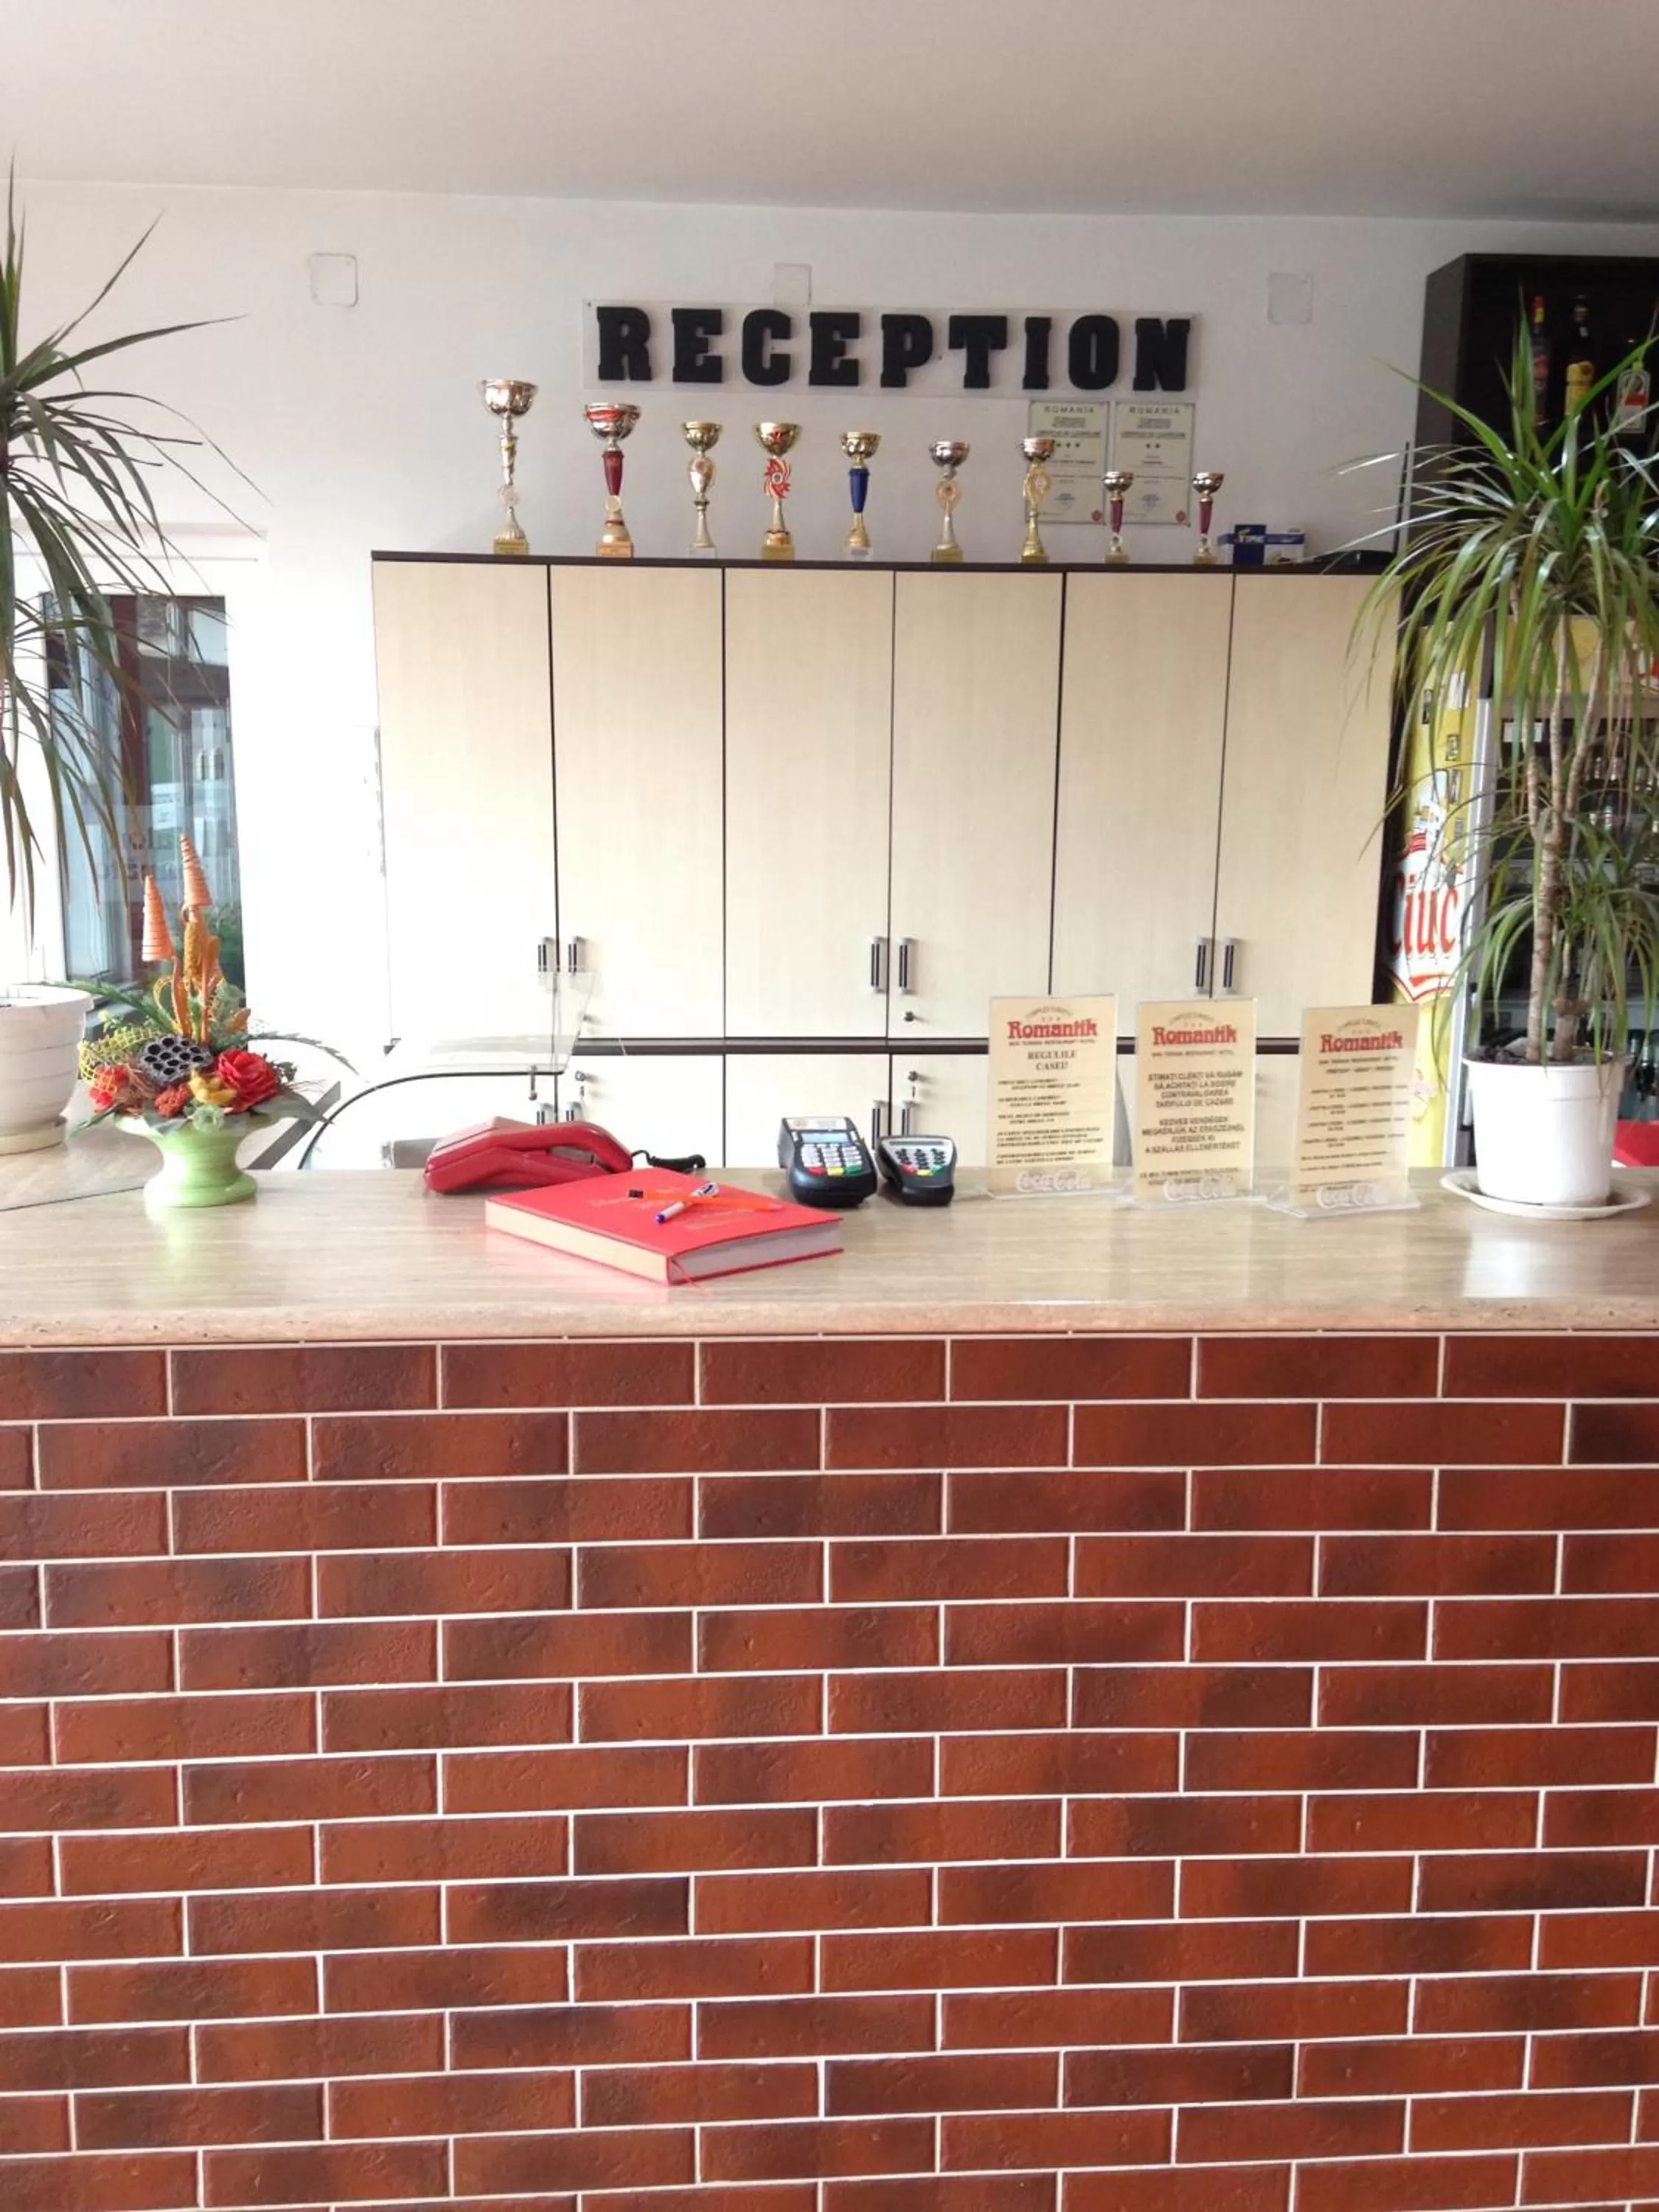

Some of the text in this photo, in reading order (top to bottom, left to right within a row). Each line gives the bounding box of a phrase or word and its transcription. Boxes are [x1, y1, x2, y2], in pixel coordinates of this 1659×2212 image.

[597, 306, 1191, 392] RECEPTION
[1007, 1018, 1097, 1039] Romantik
[1152, 1024, 1237, 1046] Romantik
[1320, 1031, 1403, 1053] Romantik
